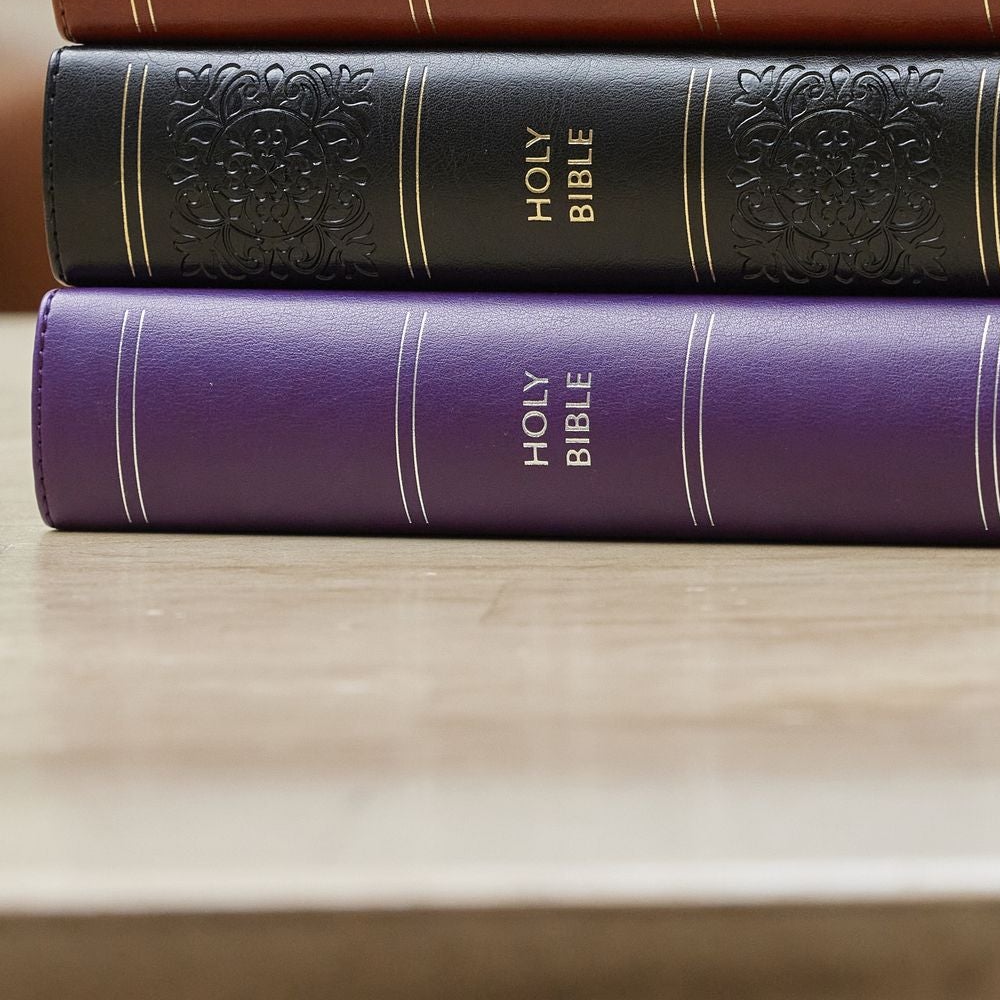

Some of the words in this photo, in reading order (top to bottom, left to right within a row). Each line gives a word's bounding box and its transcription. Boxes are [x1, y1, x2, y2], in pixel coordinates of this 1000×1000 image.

[526, 126, 552, 222] HOLY
[569, 127, 594, 224] BIBLE
[522, 370, 549, 466] HOLY
[565, 371, 591, 468] BIBLE
